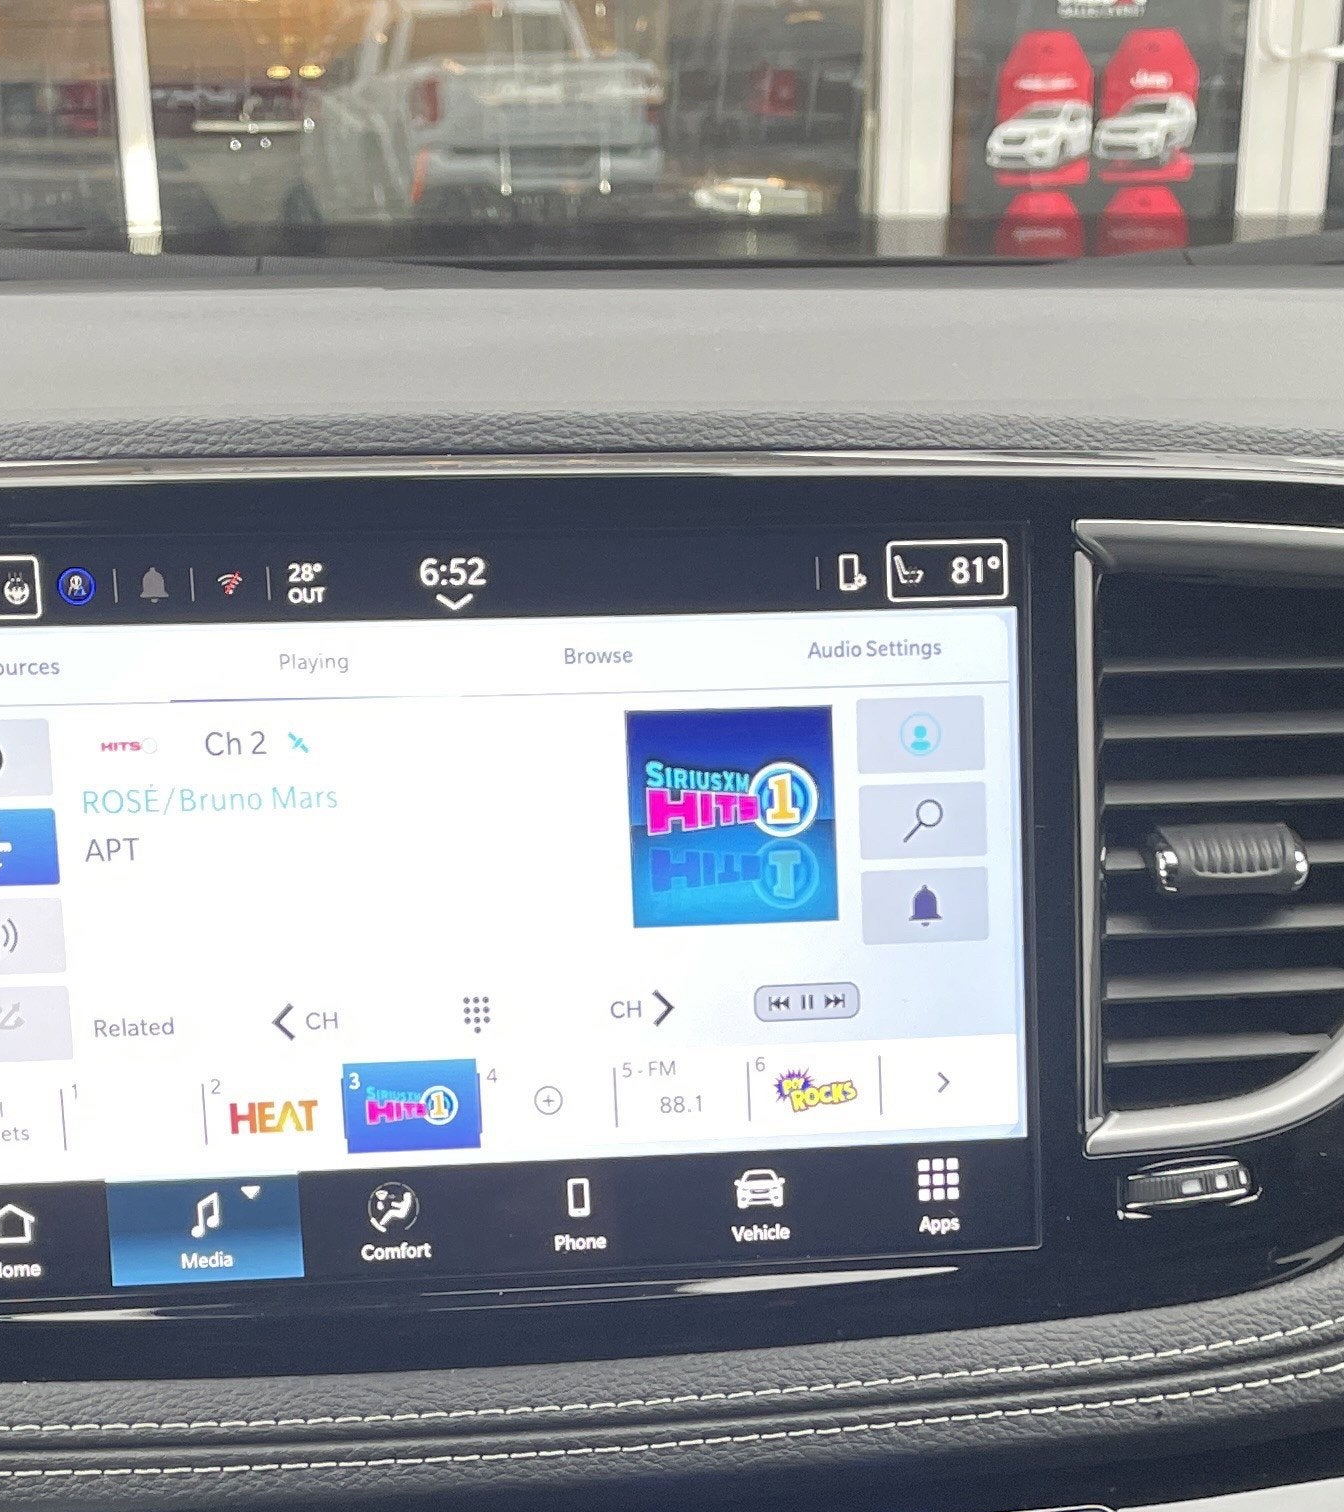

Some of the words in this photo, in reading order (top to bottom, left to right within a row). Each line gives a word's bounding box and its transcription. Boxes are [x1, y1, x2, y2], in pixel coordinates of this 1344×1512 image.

[418, 556, 487, 588] 6:52
[288, 586, 325, 605] OUT
[564, 645, 634, 666] Browse
[807, 639, 863, 660] Audio
[866, 637, 943, 661] Settings
[278, 652, 350, 675] Playing
[100, 740, 143, 753] HITS
[205, 731, 243, 757] Ch
[250, 730, 268, 755] 2
[271, 785, 339, 811] Mars
[85, 836, 140, 863] APT
[610, 999, 644, 1020] CH
[93, 1016, 176, 1039] Related
[305, 1011, 339, 1031] CH
[622, 1061, 633, 1079] 5
[649, 1059, 677, 1078] FM
[755, 1055, 766, 1073] 6
[348, 1071, 362, 1091] 3
[486, 1068, 498, 1084] 4
[210, 1078, 222, 1096] 2
[790, 1079, 858, 1113] ROCKS
[659, 1094, 703, 1115] 88.1
[229, 1099, 319, 1135] HEAT
[731, 1223, 792, 1243] Vehicle
[918, 1214, 961, 1236] Apps
[360, 1241, 433, 1262] Comfort
[554, 1233, 607, 1253] Phone
[180, 1250, 234, 1271] Media
